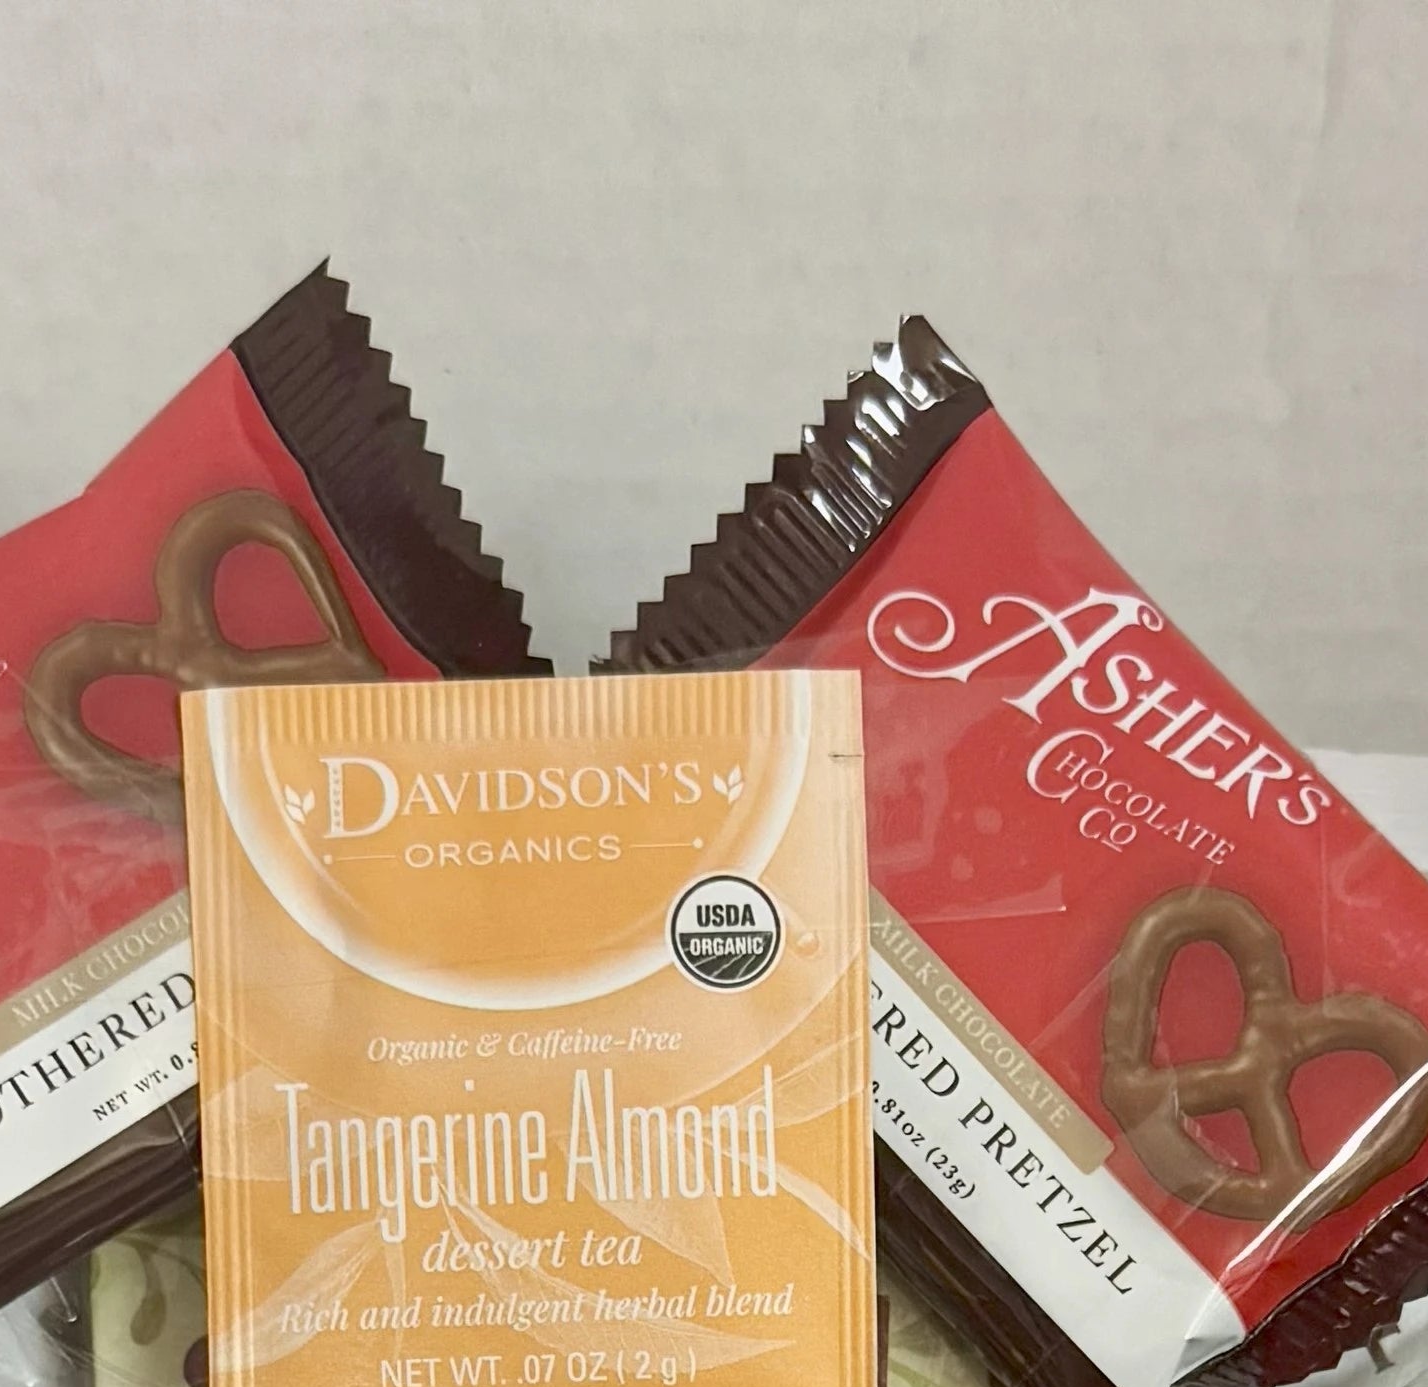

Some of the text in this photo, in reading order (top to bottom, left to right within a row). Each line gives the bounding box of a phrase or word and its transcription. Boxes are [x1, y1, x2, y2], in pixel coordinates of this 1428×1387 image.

[867, 586, 1332, 827] ASHER'S
[319, 757, 703, 838] DAVIDSON'S
[1027, 728, 1236, 866] CHOCOLATE
[405, 836, 622, 868] ORGANICS
[697, 904, 756, 927] USDA
[690, 937, 764, 957] ORGANIC
[12, 973, 84, 1026] MILK
[872, 918, 1071, 1129] MILK CHOCOLATE
[367, 1028, 682, 1066] Organic & Caffeine-Free
[93, 1091, 128, 1121] NET
[134, 1069, 169, 1094] WT.
[274, 1066, 777, 1242] Tangerine Almond
[925, 1146, 976, 1200] (23g)
[958, 1097, 1137, 1296] PRETZEL
[423, 1230, 643, 1273] dessert tea
[280, 1284, 795, 1334] Rich and indulgent herbal blend
[449, 1356, 507, 1387] WT.
[517, 1353, 554, 1384] .07
[567, 1351, 608, 1382] OZ
